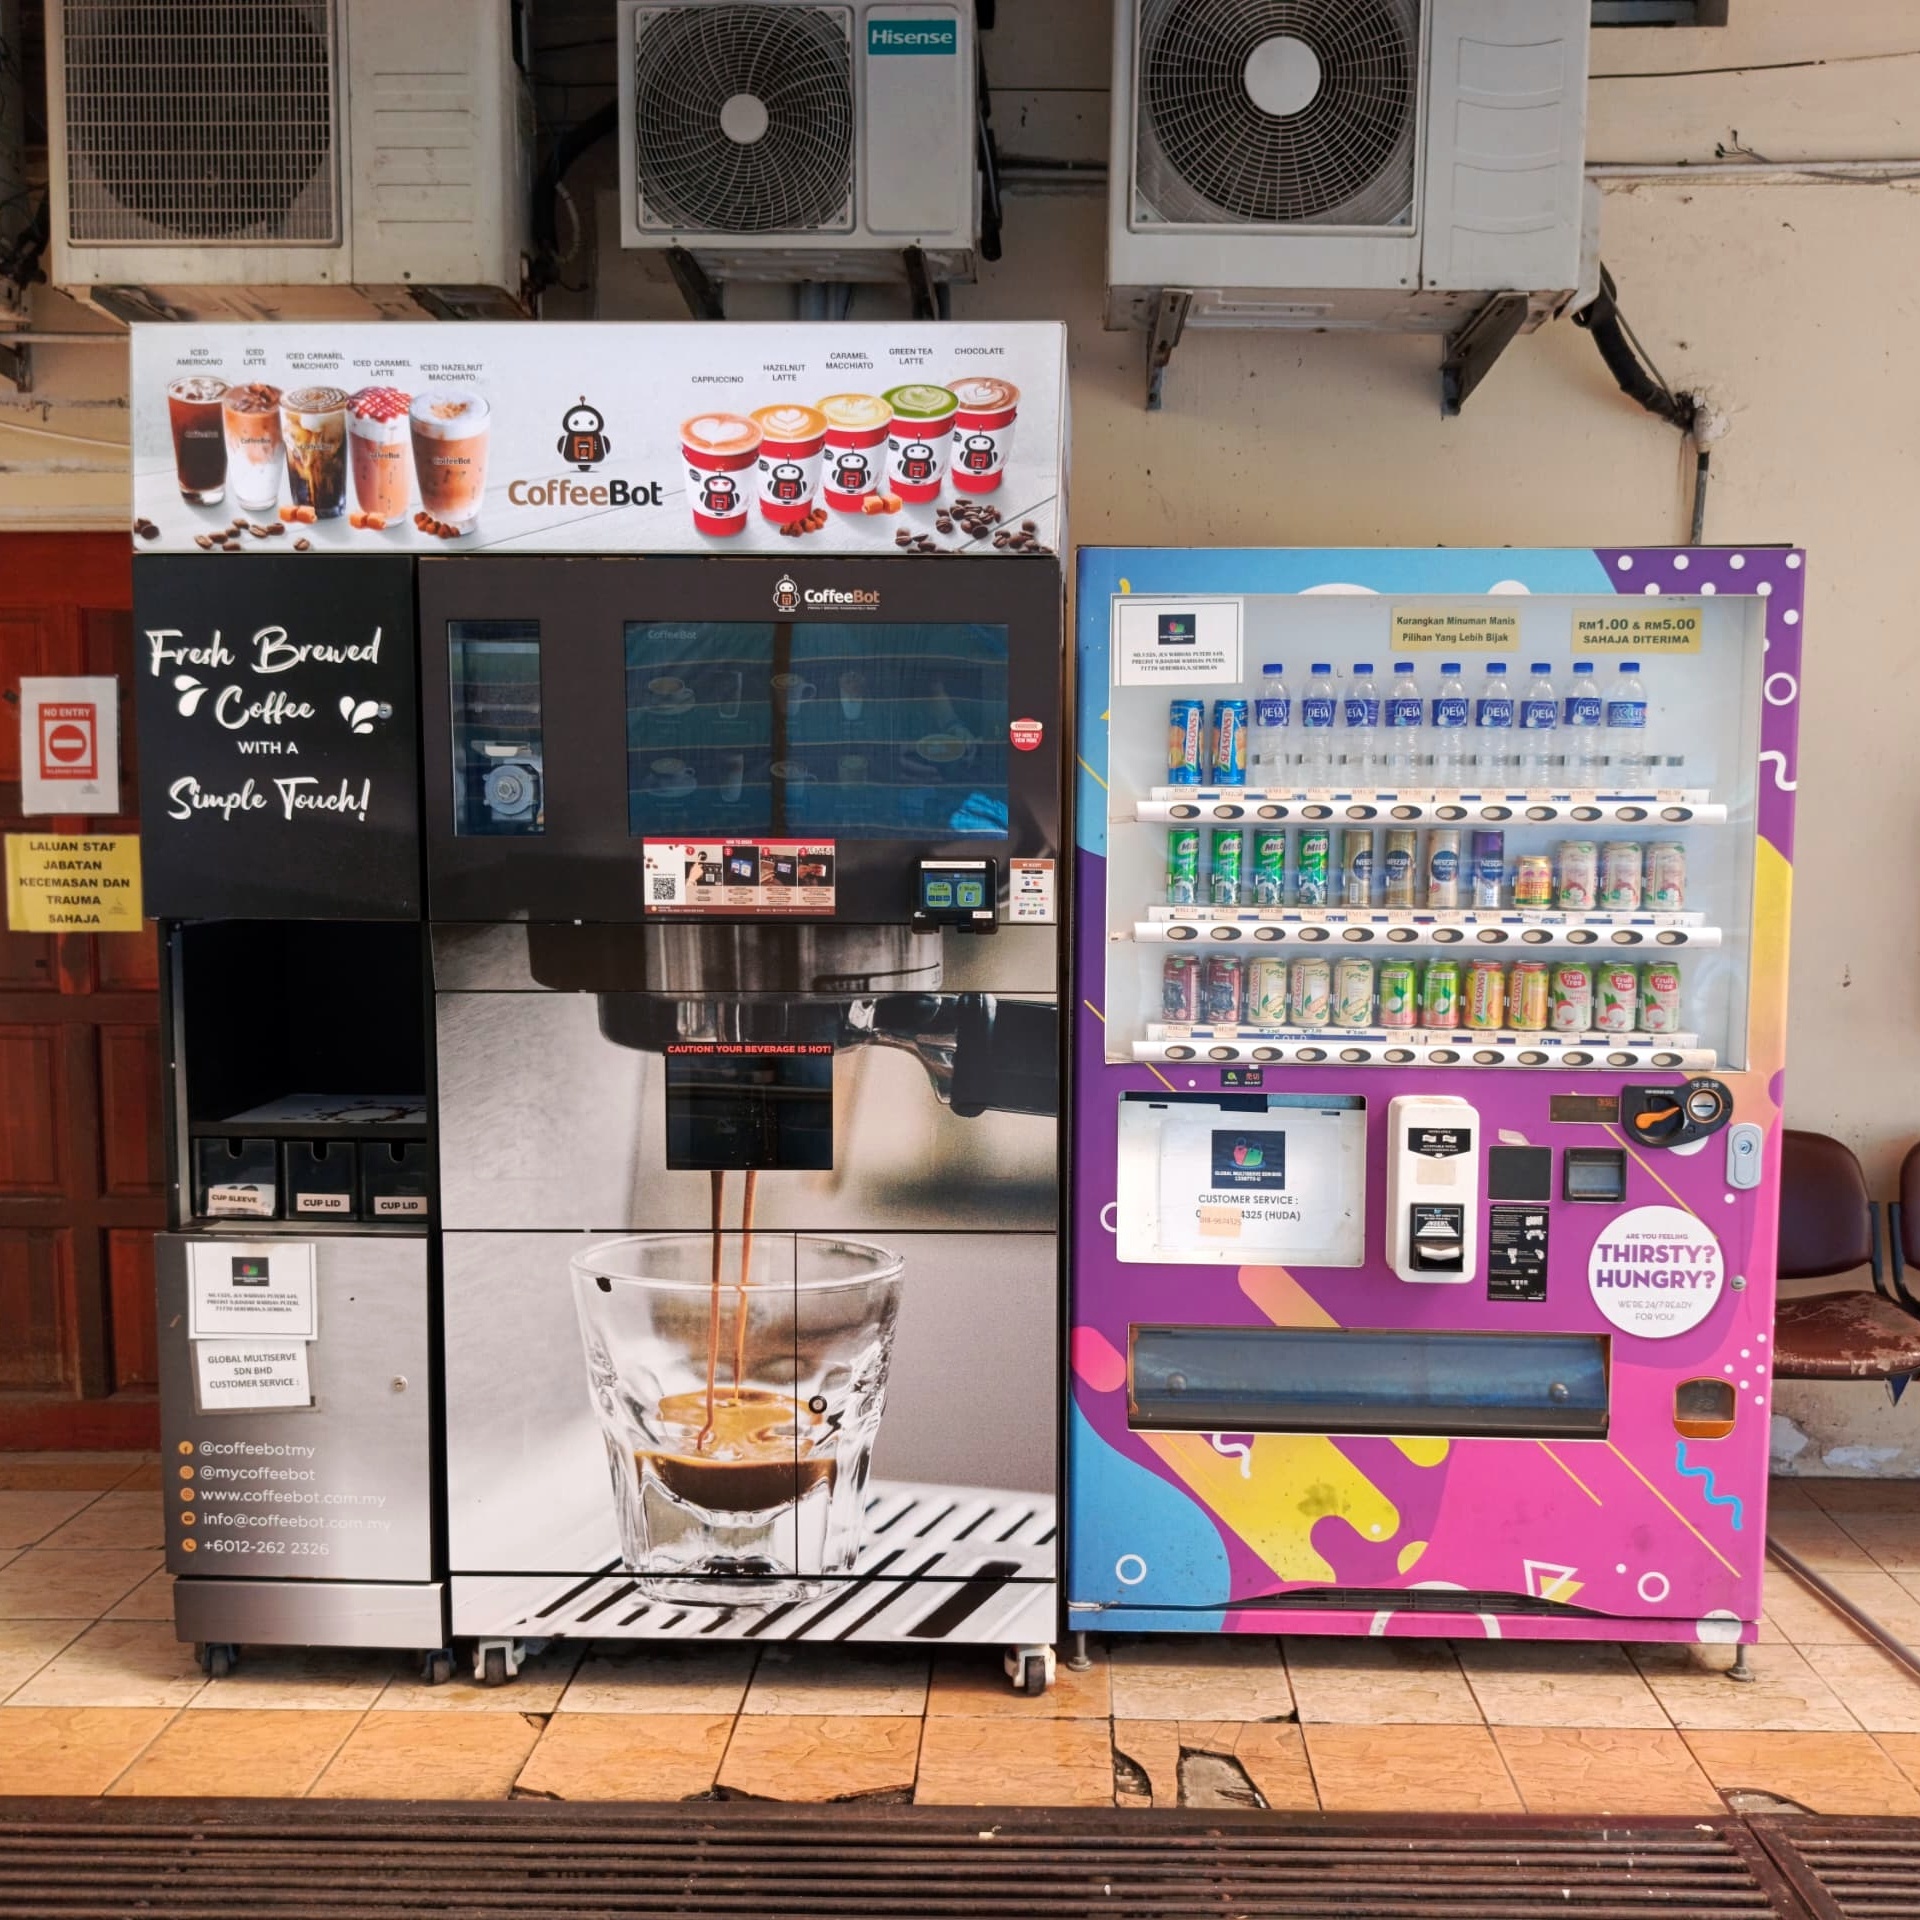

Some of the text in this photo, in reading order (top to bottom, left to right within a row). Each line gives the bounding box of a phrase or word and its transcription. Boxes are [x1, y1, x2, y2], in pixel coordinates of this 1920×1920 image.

[871, 28, 954, 46] Hisense
[190, 348, 209, 356] ICED
[246, 348, 264, 356] ICED
[286, 352, 344, 360] ICED CARAMEL
[830, 352, 869, 361] CARAMEL
[888, 347, 934, 356] GREEN TEA
[954, 347, 1005, 356] CHOCOLATE
[176, 358, 223, 366] AMERICANO
[243, 358, 266, 366] LATTE
[292, 362, 339, 370] MACCHIATO
[374, 360, 412, 368] CARAMEL
[826, 362, 874, 370] MACCHIATO
[899, 357, 924, 366] LATTE
[763, 364, 806, 373] HAZELNUT
[428, 374, 476, 382] MACCHIATO
[692, 376, 744, 384] CAPPUCCINO
[772, 374, 798, 382] LATTE
[508, 478, 663, 507] CoffeeBot
[804, 589, 880, 604] CoffeeBot
[1396, 616, 1516, 626] Kurangkan Minuman Manis
[1579, 618, 1696, 631] RM1.00 & RM5.00
[1402, 633, 1508, 644] Pilihan Yang Lebih Bijak
[1583, 634, 1690, 644] SAHAJA DITERIMA
[144, 625, 382, 678] Fresh Brewed
[214, 684, 316, 730] Coffee
[1260, 706, 1284, 718] DESA
[1307, 706, 1330, 718] DESA
[1399, 706, 1421, 717] DESA
[1442, 706, 1466, 718] DESA
[1486, 706, 1510, 718] DESA
[1578, 705, 1600, 716] DESA
[44, 708, 91, 718] NO ENTRY
[1530, 708, 1554, 720] DESA
[1186, 718, 1198, 764] SEASONS
[1220, 718, 1232, 764] SEASONS
[237, 740, 299, 754] WITH A
[167, 776, 371, 822] Simple Touch!
[30, 841, 116, 852] LALUAN STAF
[1306, 840, 1327, 851] MILO
[43, 860, 102, 871] JABATAN
[19, 878, 130, 888] KECEMASAN DAN
[46, 894, 102, 905] TRAUMA
[48, 914, 100, 924] SAHAJA
[1564, 973, 1583, 982] Fruit
[1615, 976, 1634, 985] Fruit
[1655, 977, 1675, 986] Fruit
[1565, 980, 1582, 988] Tree
[1656, 982, 1674, 990] Tree
[1474, 970, 1486, 1017] SEASONS
[1512, 970, 1523, 1017] SEASONS
[668, 1045, 832, 1054] CAUTION! YOUR BEVERAGE IS HOT!
[212, 1194, 258, 1204] CUP SLEEVE
[303, 1199, 323, 1207] CUP
[1198, 1194, 1250, 1204] CUSTOMER
[1252, 1195, 1293, 1205] SERVICE
[380, 1201, 418, 1210] CUP LID
[1264, 1210, 1301, 1222] (HUDA)
[1598, 1244, 1716, 1264] THIRSTY?
[1596, 1270, 1716, 1289] HUNGRY?
[1666, 1300, 1692, 1310] READY
[1635, 1312, 1675, 1320] FOR YOU!
[208, 1353, 296, 1364] GLOBAL MULTISERVE
[234, 1366, 273, 1376] SDN BHD
[210, 1379, 258, 1388] CUSTOMER
[260, 1378, 294, 1387] SERVICE
[199, 1441, 316, 1458] @coffeebotmy
[200, 1465, 316, 1482] @mycoffeebot
[200, 1488, 386, 1508] www.coffeebot.com.my
[204, 1512, 392, 1532] info@coffeebot.com.my
[204, 1540, 330, 1556] +6012-262 2326
